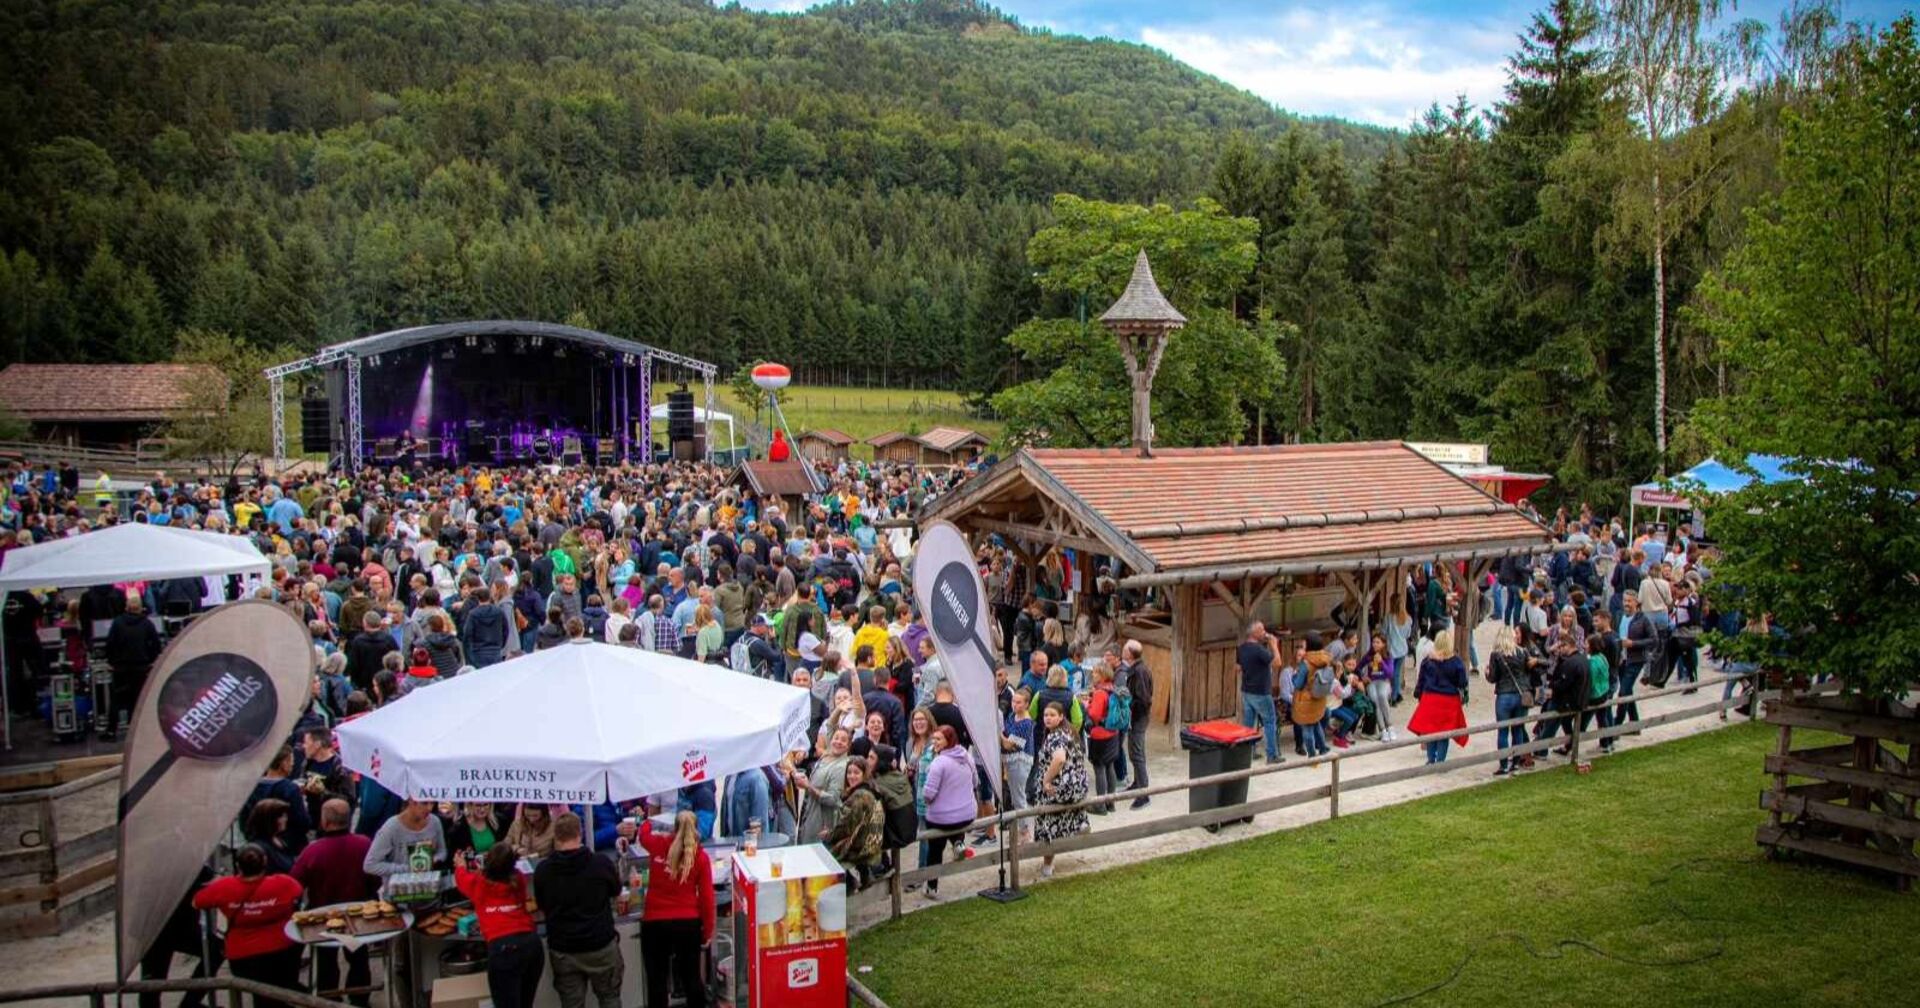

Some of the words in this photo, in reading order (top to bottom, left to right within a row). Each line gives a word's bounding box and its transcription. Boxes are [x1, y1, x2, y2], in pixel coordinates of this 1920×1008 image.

[172, 672, 241, 739] HERMANN
[188, 675, 262, 750] FLEISCHLOS
[460, 769, 557, 783] BRAUKUNST
[681, 754, 707, 778] Stiegl
[418, 787, 450, 799] AUF
[456, 784, 545, 799] HÖCHSTER
[548, 788, 597, 802] STUFE
